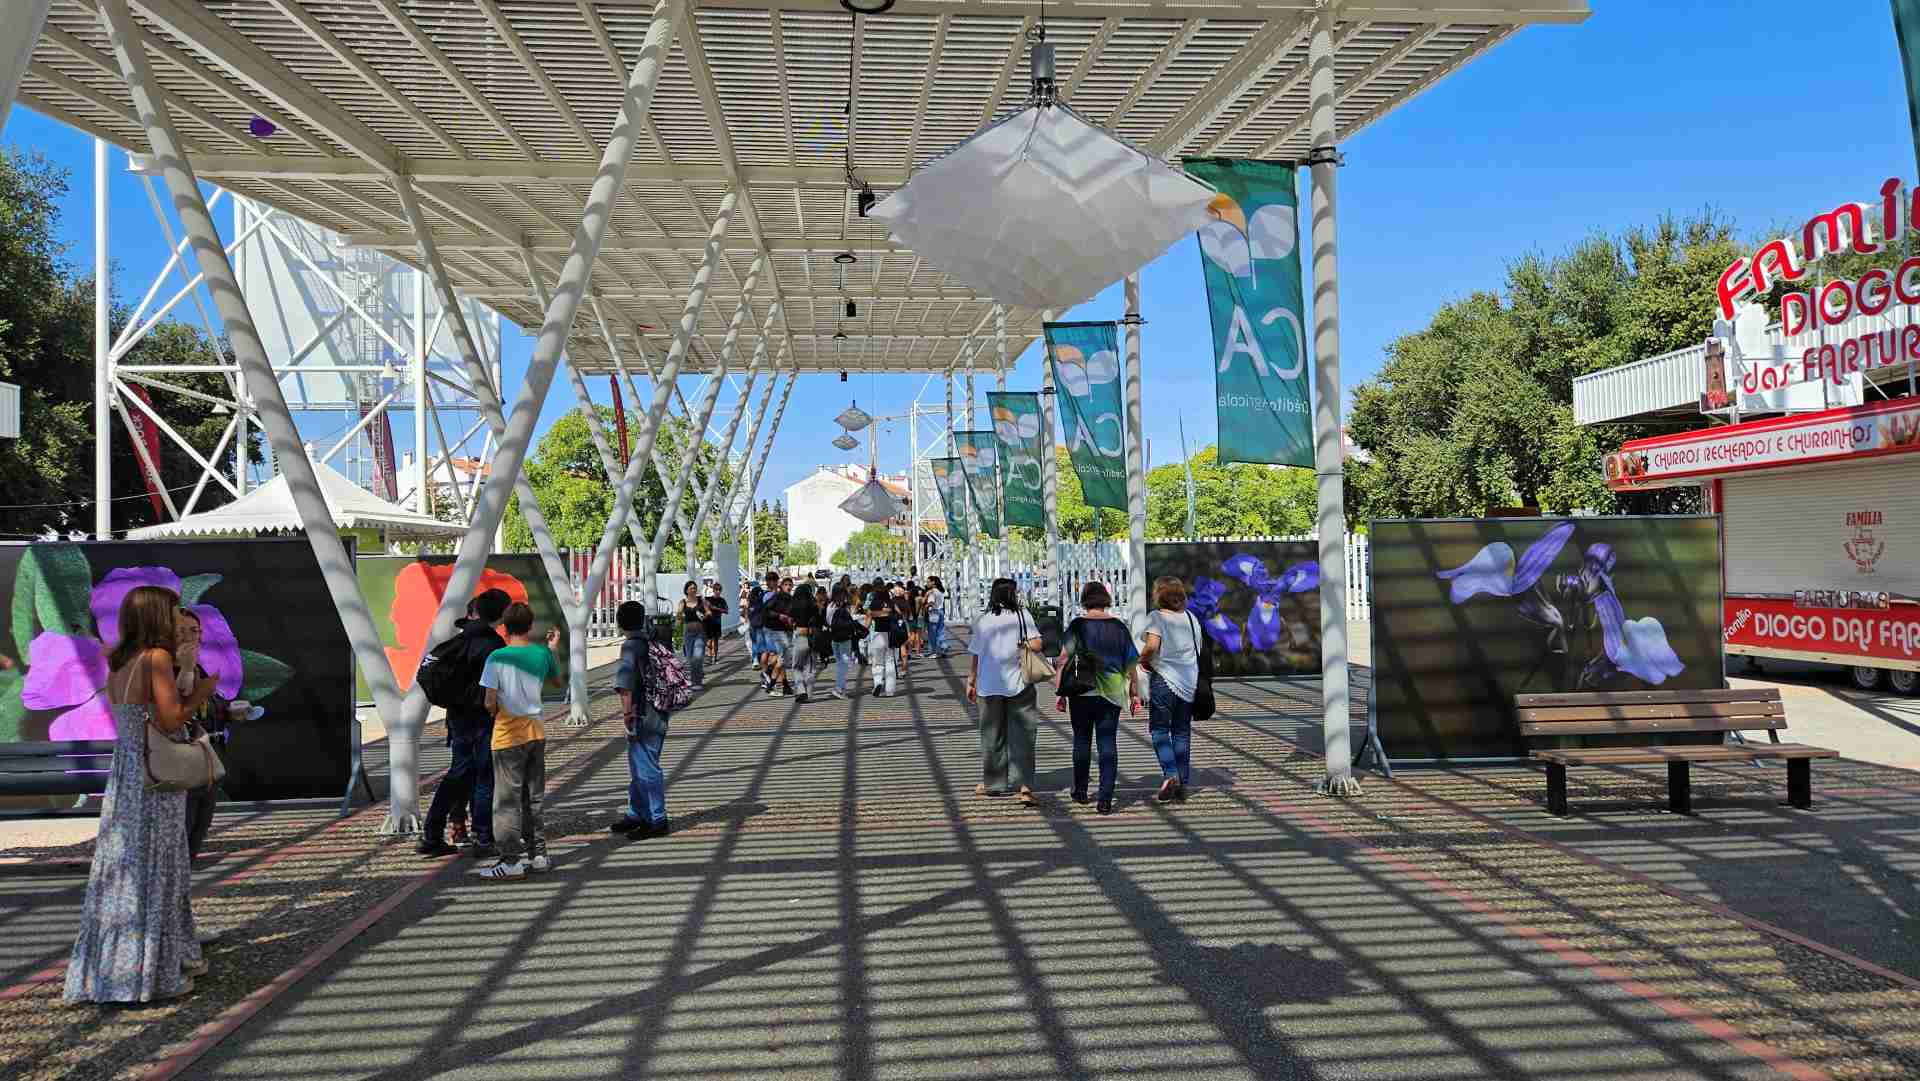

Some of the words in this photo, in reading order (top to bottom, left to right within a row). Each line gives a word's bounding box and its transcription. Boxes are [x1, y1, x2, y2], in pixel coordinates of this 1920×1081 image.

[1781, 256, 1920, 336] DIOGO
[1743, 362, 1794, 394] das
[1654, 448, 1700, 470] CHURROS
[1703, 439, 1772, 463] RECHEADOS
[1776, 437, 1784, 452] E
[1787, 423, 1872, 454] CHURRINHOS
[1753, 612, 1826, 641] DIOGO
[1832, 616, 1874, 652] DAS
